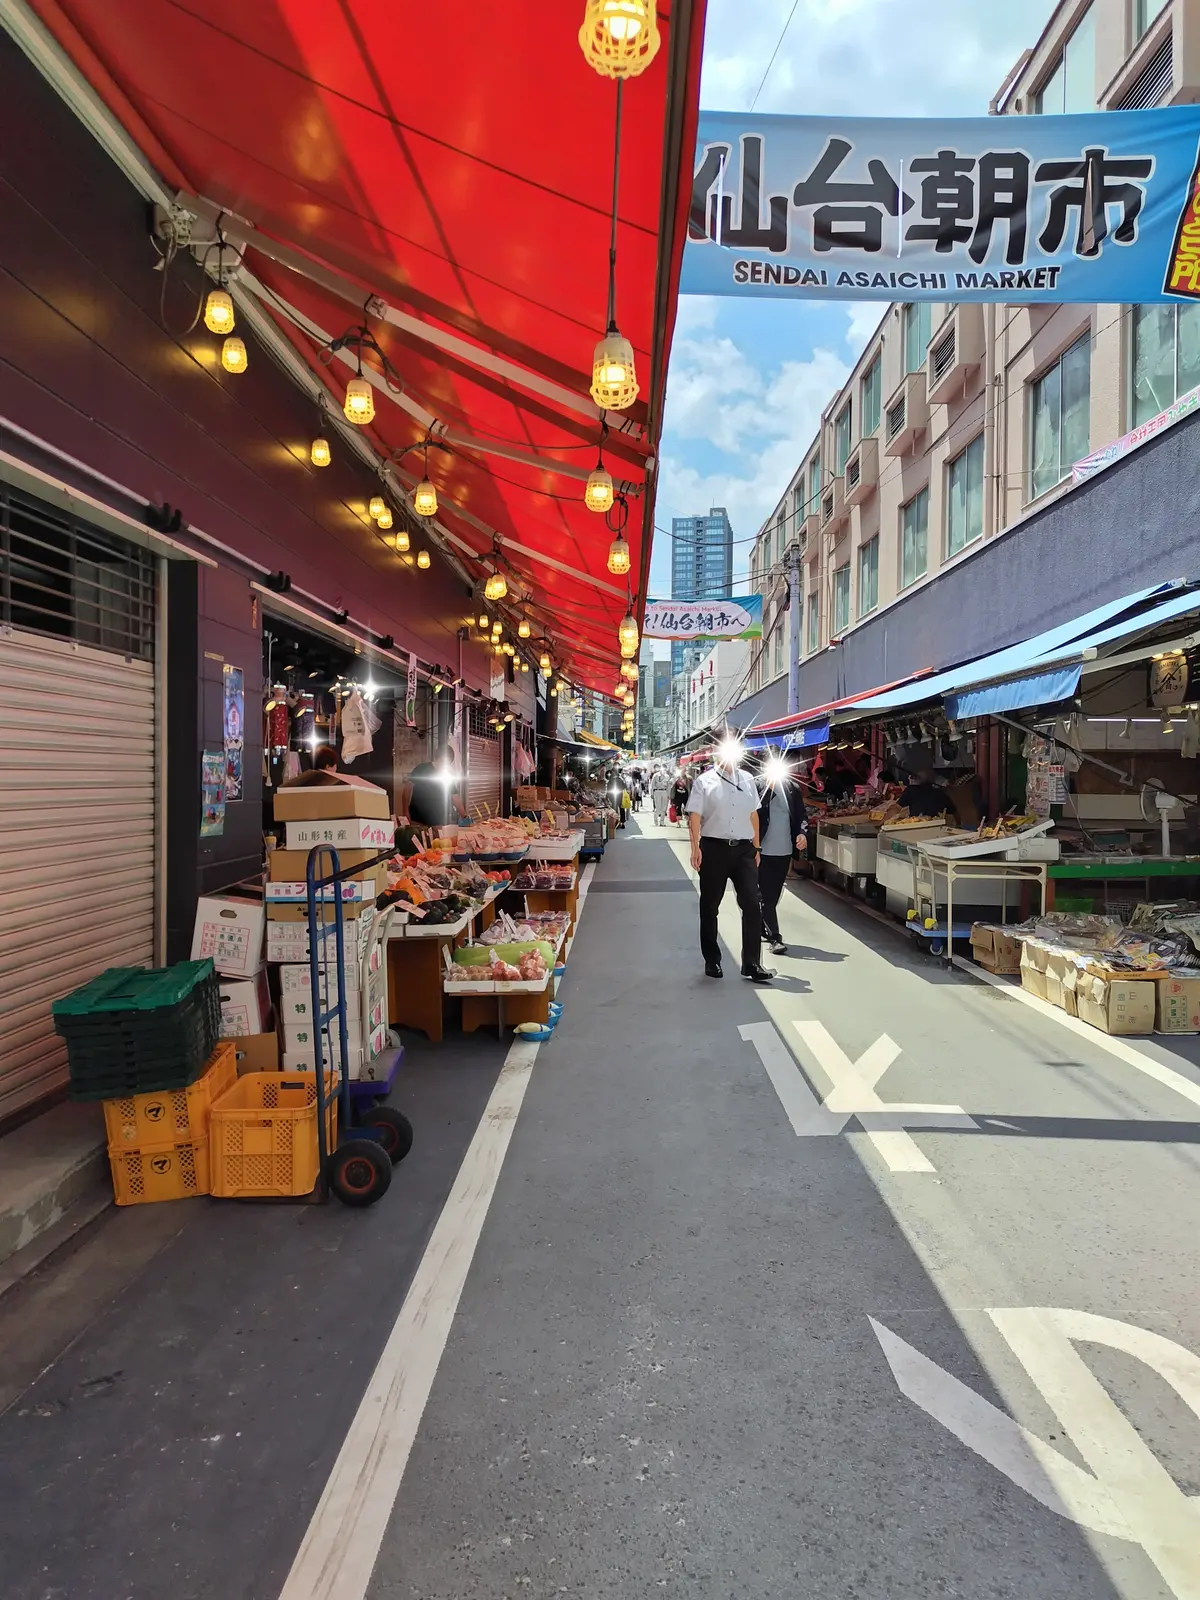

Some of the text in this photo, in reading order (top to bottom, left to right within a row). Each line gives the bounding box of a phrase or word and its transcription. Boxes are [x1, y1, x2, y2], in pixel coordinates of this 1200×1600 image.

[688, 136, 1153, 265] 仙台朝市
[734, 260, 1062, 290] SENDAI ASAICHI MARKET
[298, 829, 348, 841] 山形特産
